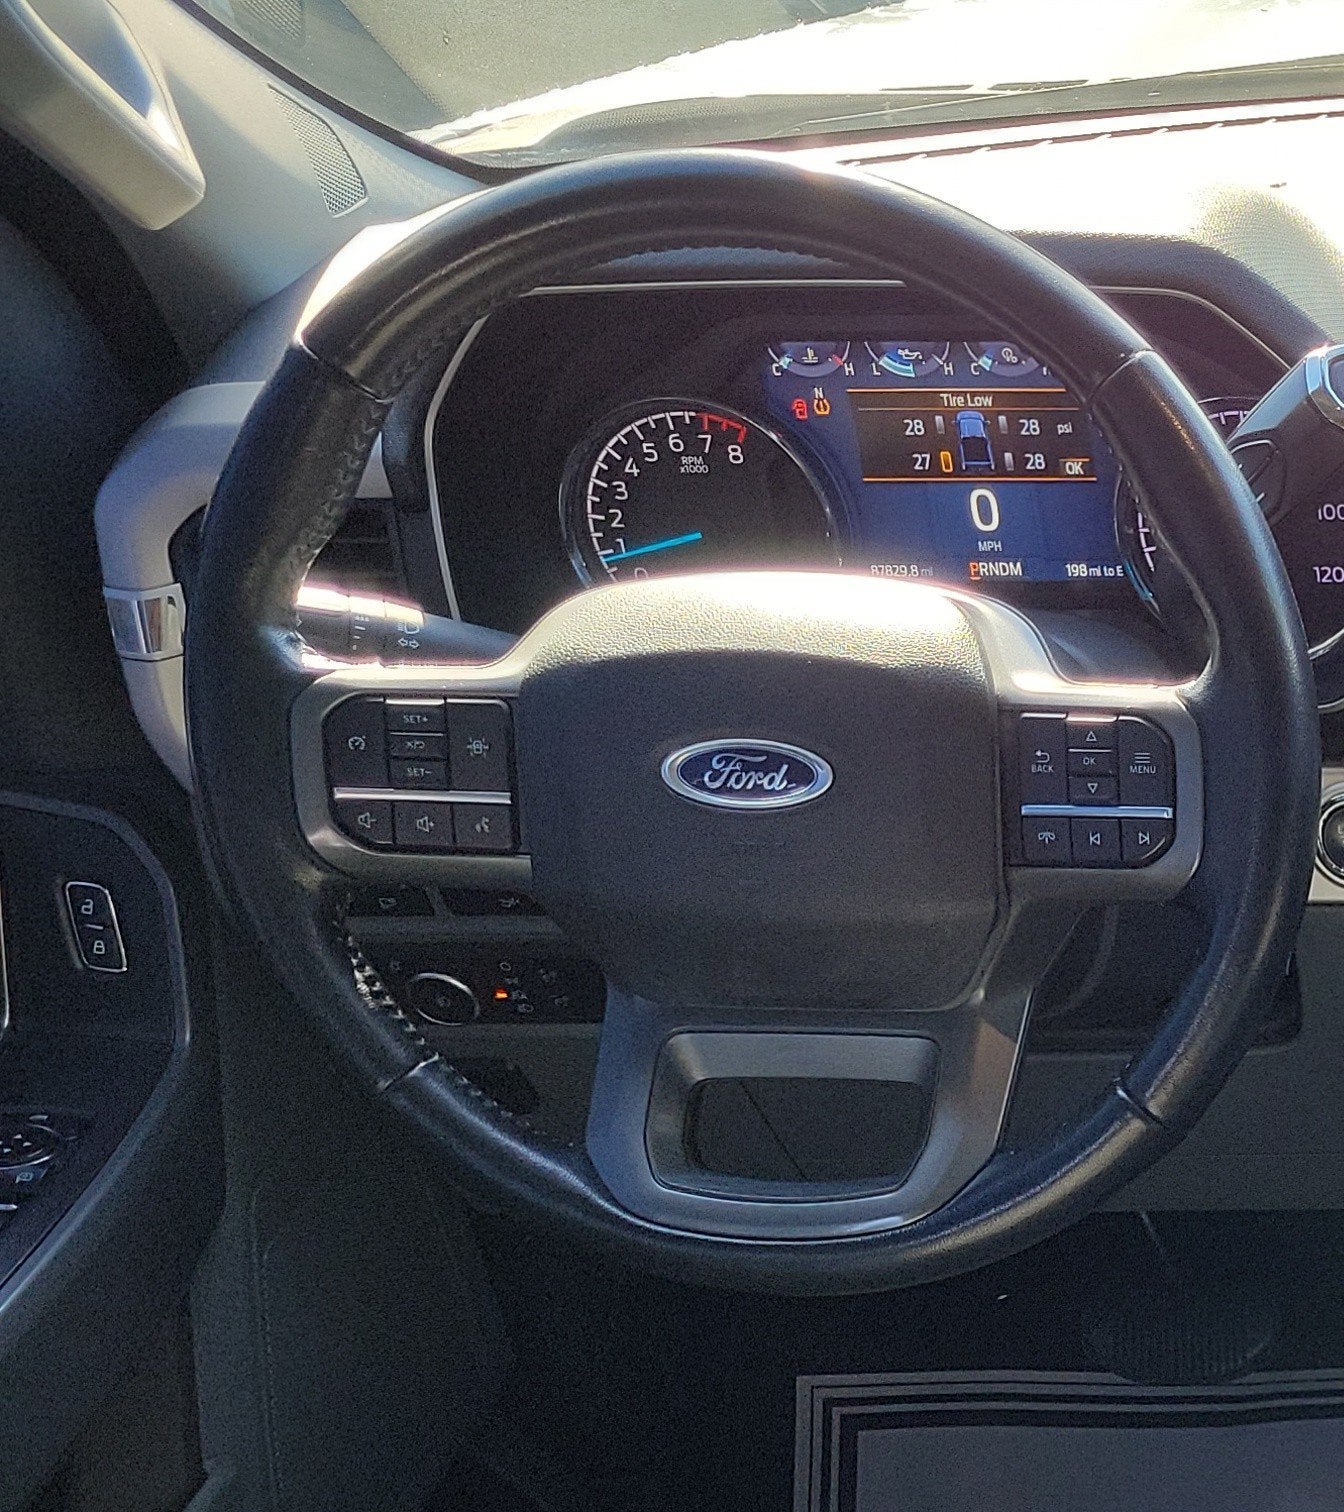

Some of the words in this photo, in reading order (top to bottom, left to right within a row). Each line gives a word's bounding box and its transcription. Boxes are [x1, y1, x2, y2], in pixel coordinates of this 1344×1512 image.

[771, 363, 782, 376] C
[843, 363, 855, 376] H
[872, 363, 881, 376] L
[943, 363, 954, 376] H
[970, 363, 980, 376] C
[939, 392, 965, 407] Tire
[966, 392, 993, 407] Low
[903, 418, 925, 436] 28
[1018, 418, 1040, 436] 28
[1056, 422, 1073, 435] psi
[668, 433, 685, 452] 6
[696, 434, 713, 453] 7
[642, 442, 659, 462] 5
[680, 456, 704, 465] RPM
[726, 444, 744, 464] 8
[623, 457, 641, 477] 4
[912, 453, 931, 470] 27
[1024, 453, 1046, 470] 28
[1065, 461, 1084, 475] OK
[611, 481, 629, 501] 3
[608, 508, 625, 527] 2
[969, 487, 1000, 533] 0
[978, 540, 1003, 552] MPH
[1065, 563, 1088, 577] 198
[1088, 566, 1102, 577] mi
[1103, 565, 1116, 577] to
[703, 752, 797, 791] Ford
[1031, 764, 1054, 773] BACK
[1129, 765, 1157, 774] MENU
